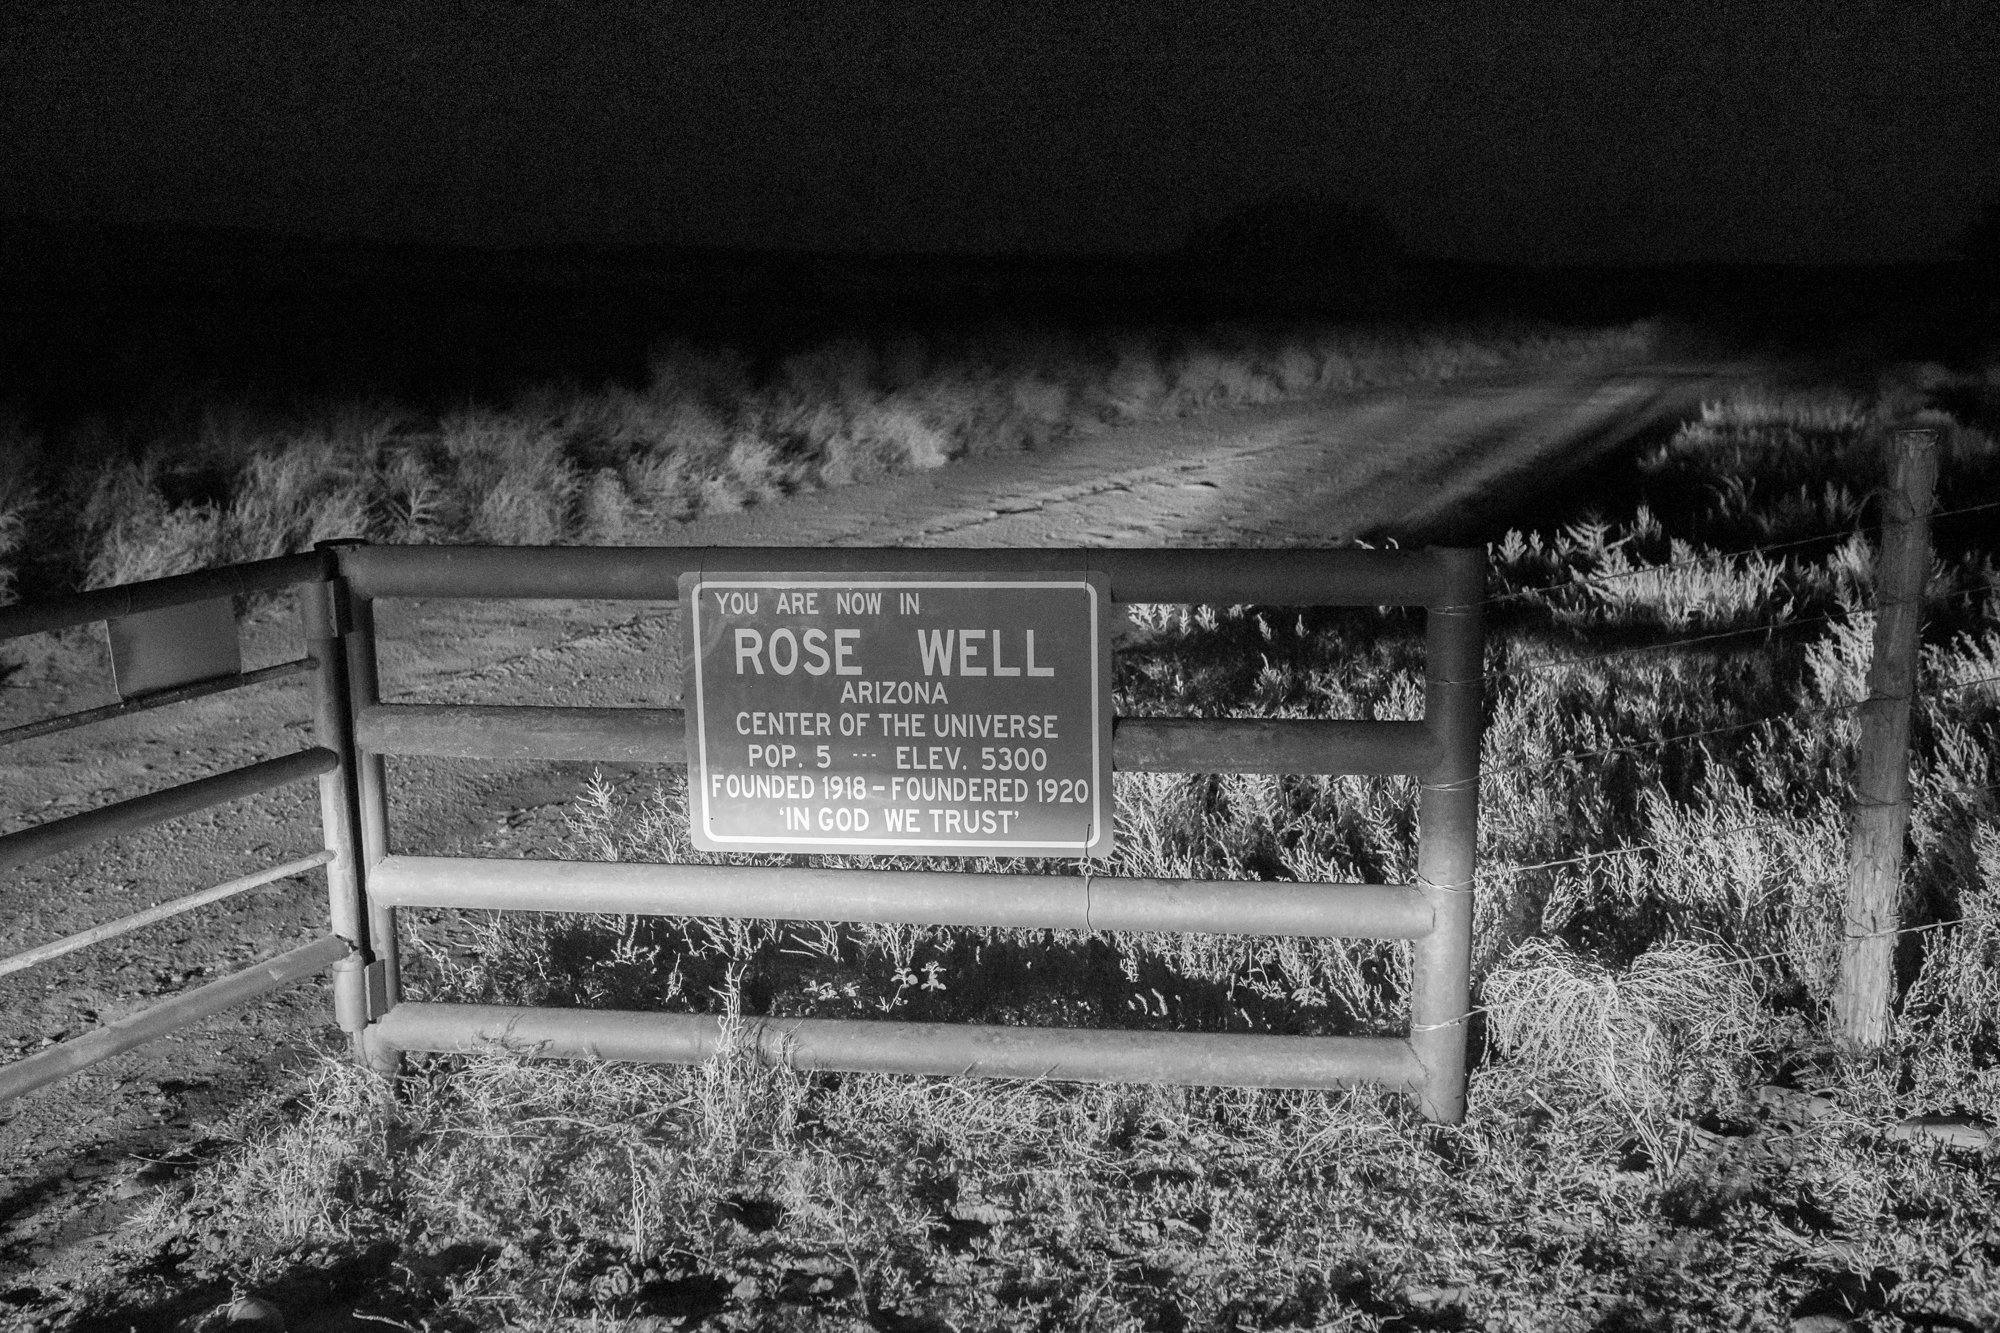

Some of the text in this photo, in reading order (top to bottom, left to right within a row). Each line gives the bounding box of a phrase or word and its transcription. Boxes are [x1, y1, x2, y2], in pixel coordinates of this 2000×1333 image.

[715, 593, 920, 614] YOU ARE NOW IN
[734, 628, 1054, 677] ROSE WELL
[840, 681, 948, 704] ARIZONA
[736, 712, 1058, 738] CENTER OF THE UNIVERSE
[749, 744, 803, 768] POP.
[817, 745, 831, 769] 5
[896, 747, 966, 770] ELEV.
[981, 747, 1046, 771] 5300
[712, 774, 815, 799] FOUNDED
[891, 778, 1028, 803] FOUNDERED
[1037, 779, 1088, 803] 1920
[818, 808, 869, 832] GOD
[884, 809, 920, 833] WE
